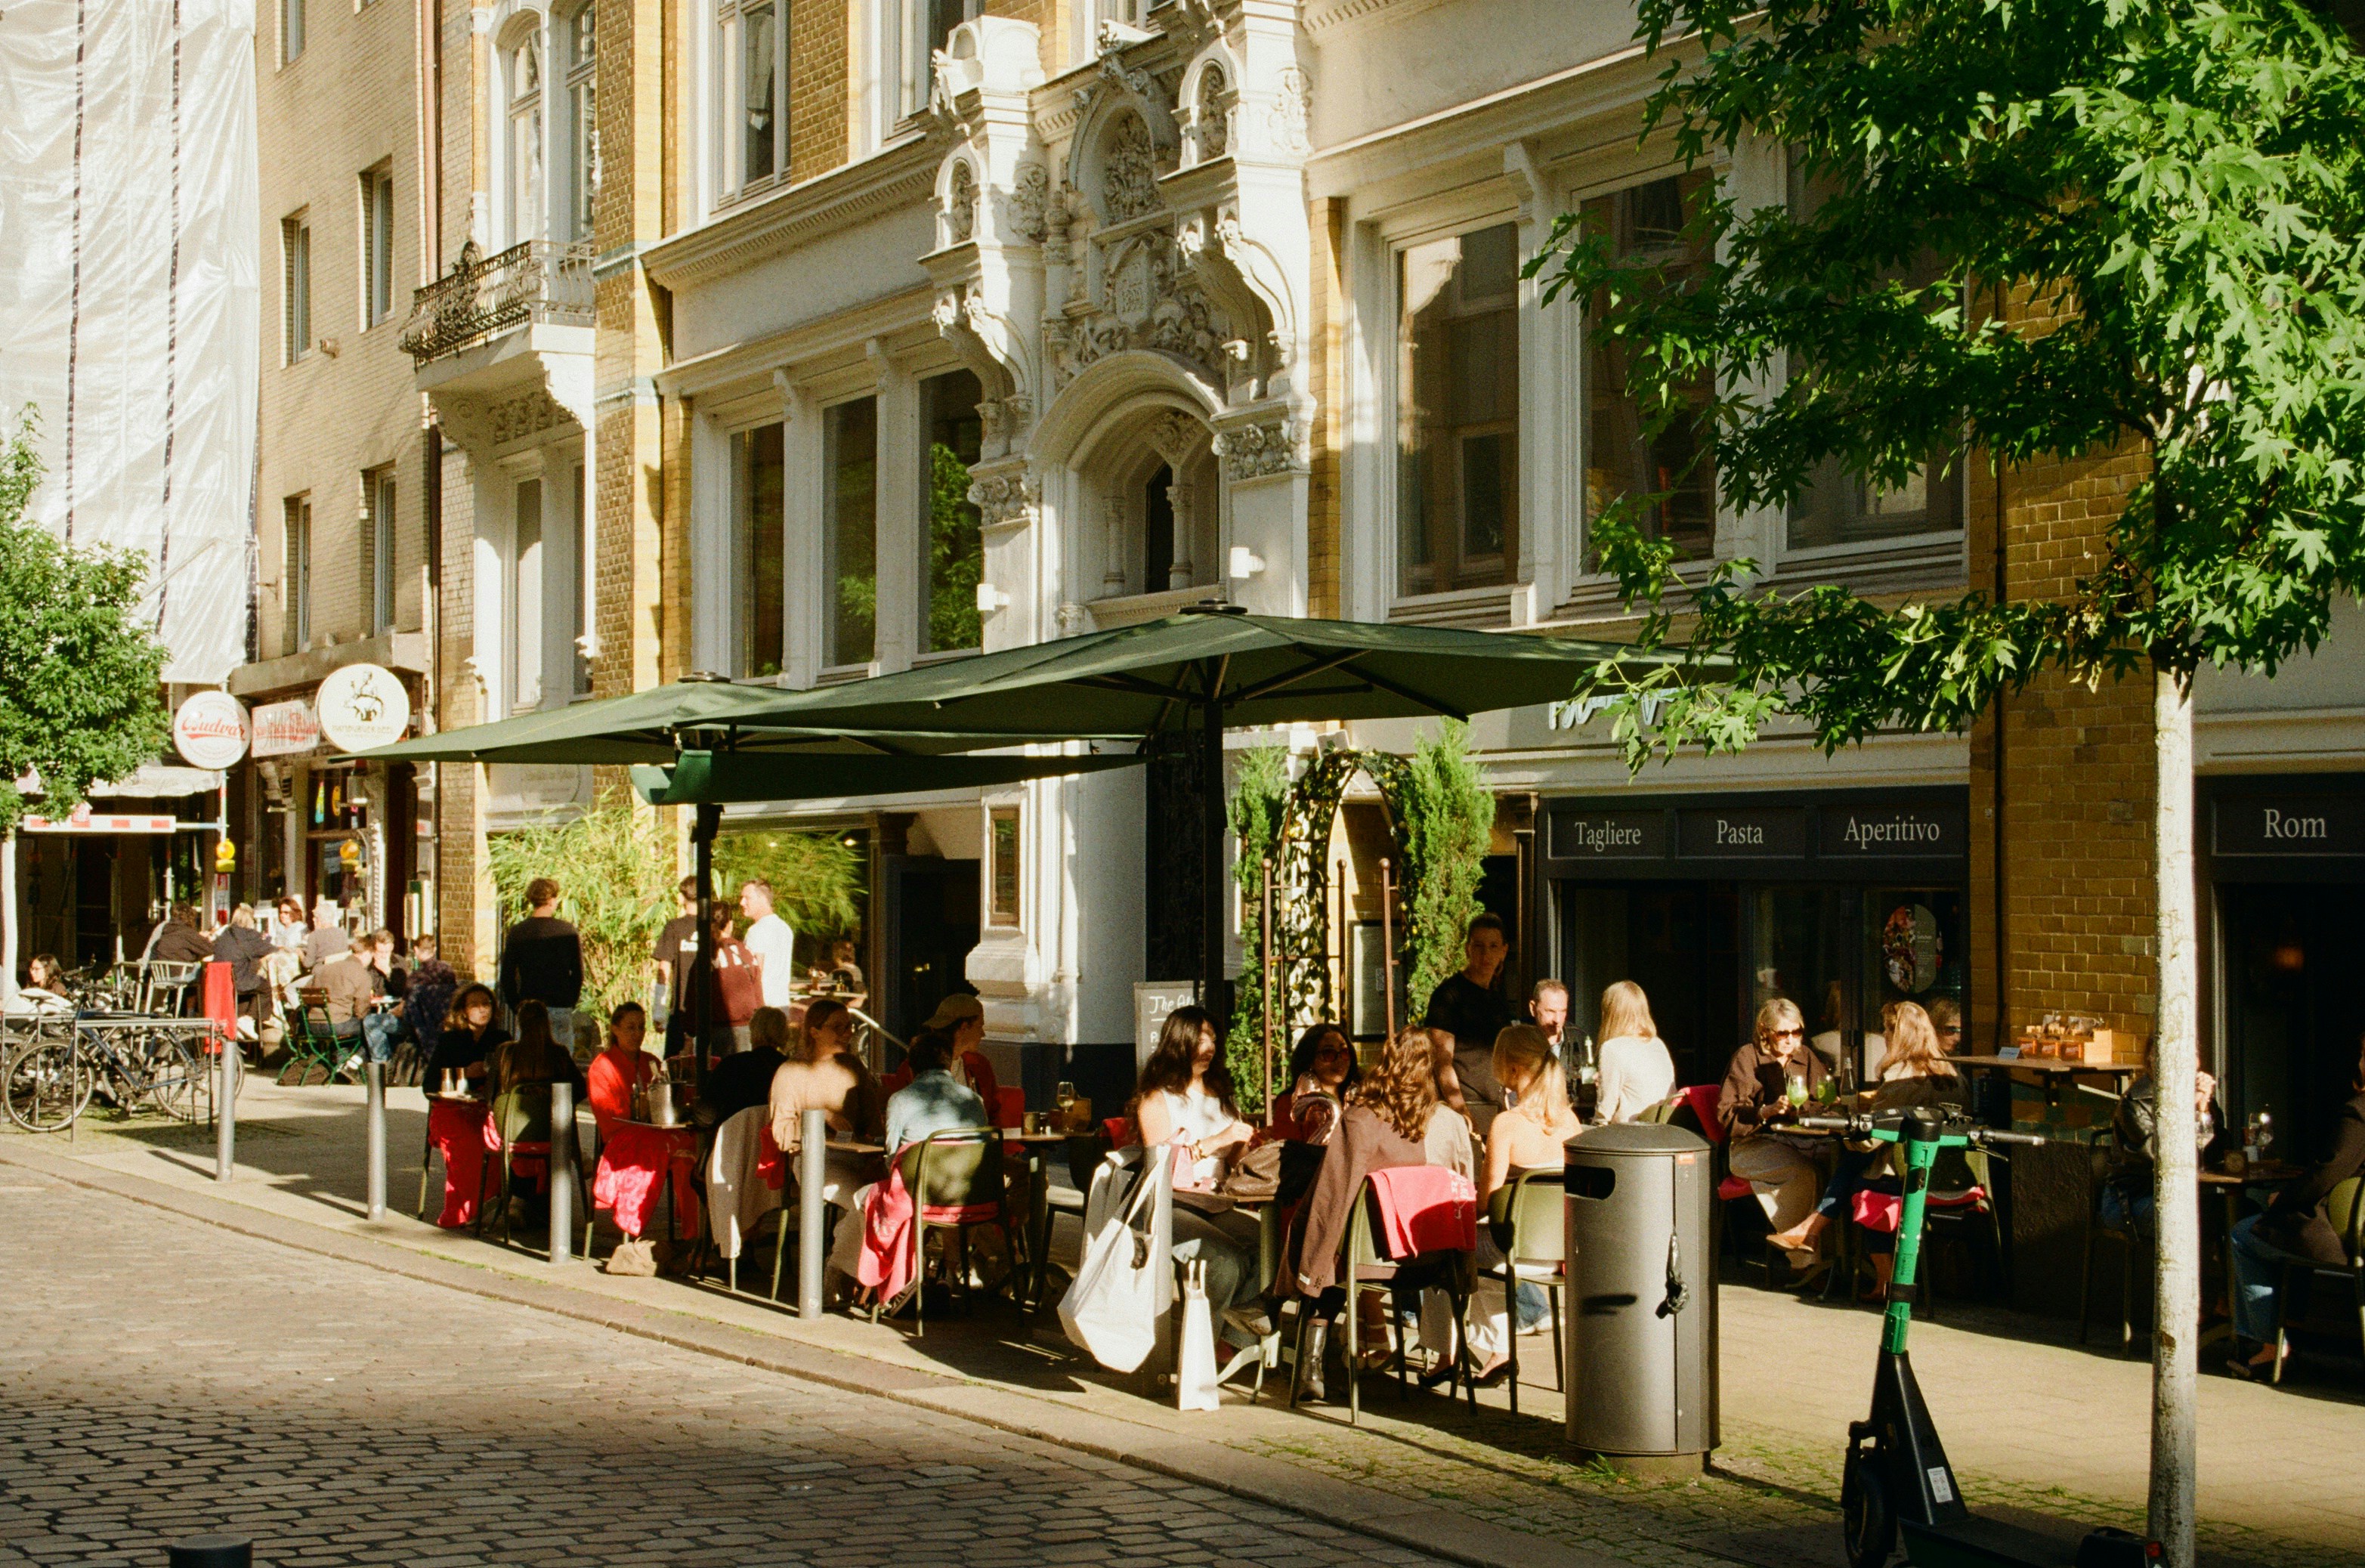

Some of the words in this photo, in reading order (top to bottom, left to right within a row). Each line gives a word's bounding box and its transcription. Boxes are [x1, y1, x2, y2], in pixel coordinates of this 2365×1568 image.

[1575, 820, 1642, 852] Tagliere
[1716, 819, 1764, 845] Pasta
[1844, 815, 1940, 850] Aperitivo
[2263, 808, 2328, 839] Rom
